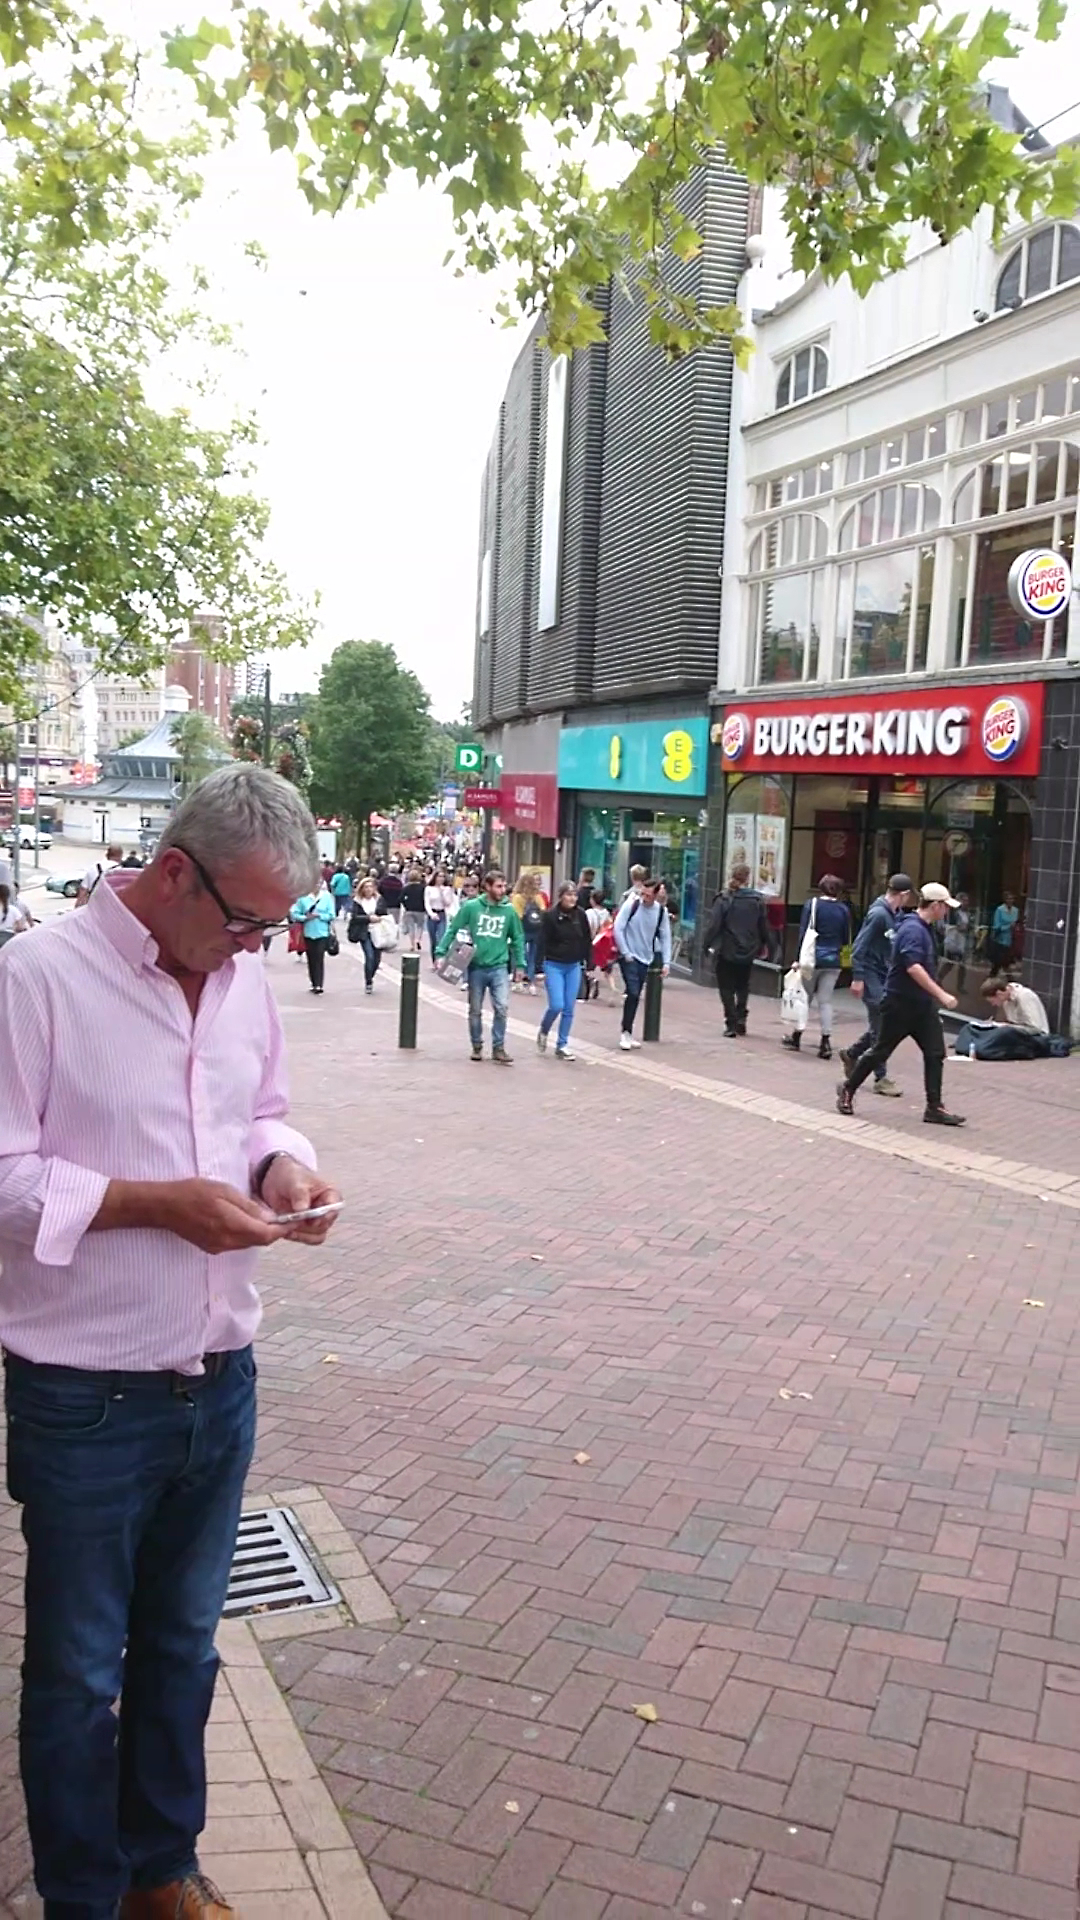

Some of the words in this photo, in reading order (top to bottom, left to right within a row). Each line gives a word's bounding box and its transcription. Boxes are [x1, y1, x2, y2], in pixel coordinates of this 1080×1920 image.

[1028, 567, 1065, 585] BURGER
[1027, 578, 1066, 601] KING
[985, 709, 1015, 730] BURGER
[753, 712, 867, 757] BURGER
[872, 708, 965, 757] KING
[984, 720, 1015, 746] KING
[459, 749, 478, 767] D
[475, 914, 506, 938] DC
